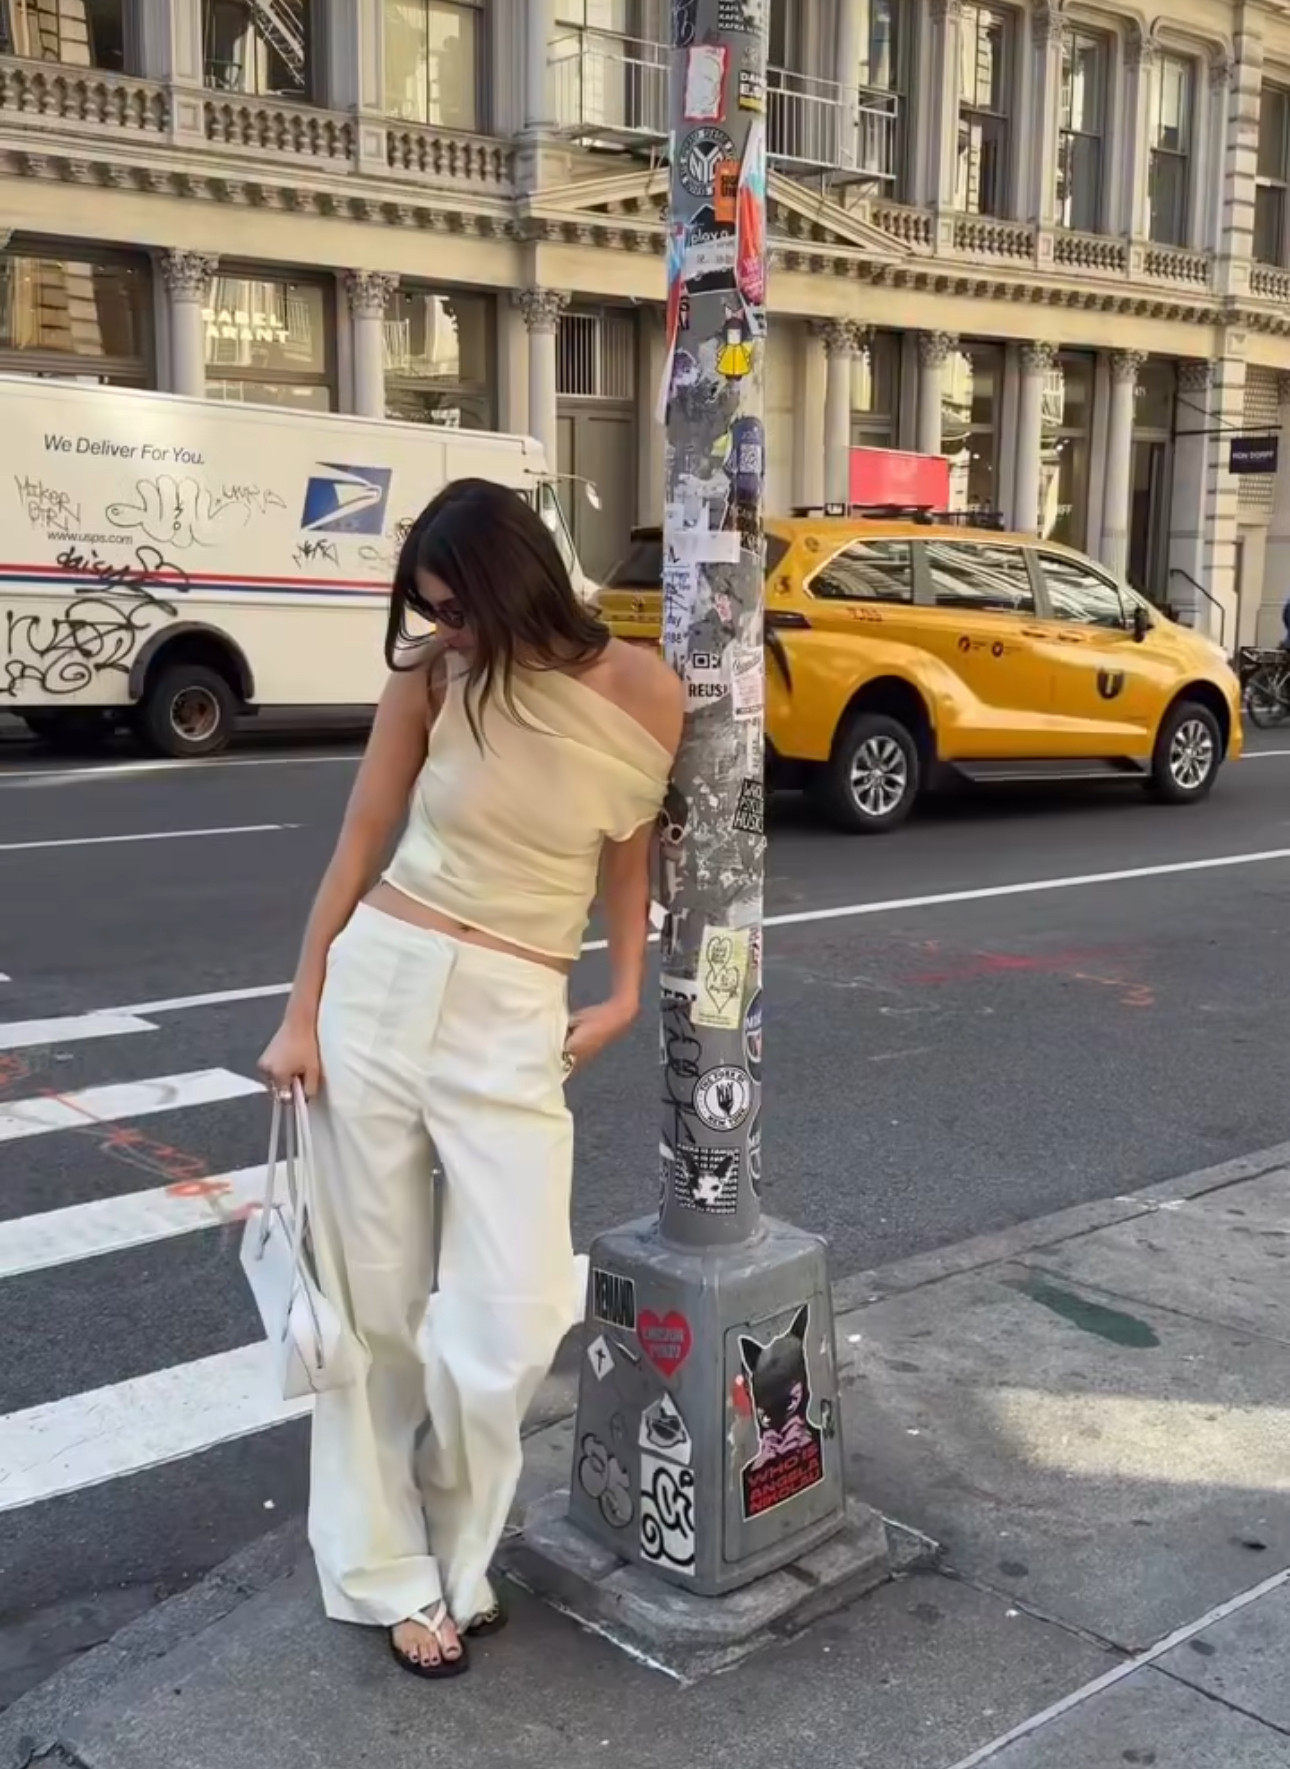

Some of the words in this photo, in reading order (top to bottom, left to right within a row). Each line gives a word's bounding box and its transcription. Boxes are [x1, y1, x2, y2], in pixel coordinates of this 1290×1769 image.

[44, 433, 73, 452] We
[76, 437, 138, 459] Deliver
[141, 444, 170, 461] For
[173, 447, 205, 465] You.
[47, 531, 134, 546] www.usps.com
[749, 1454, 799, 1487] WHO
